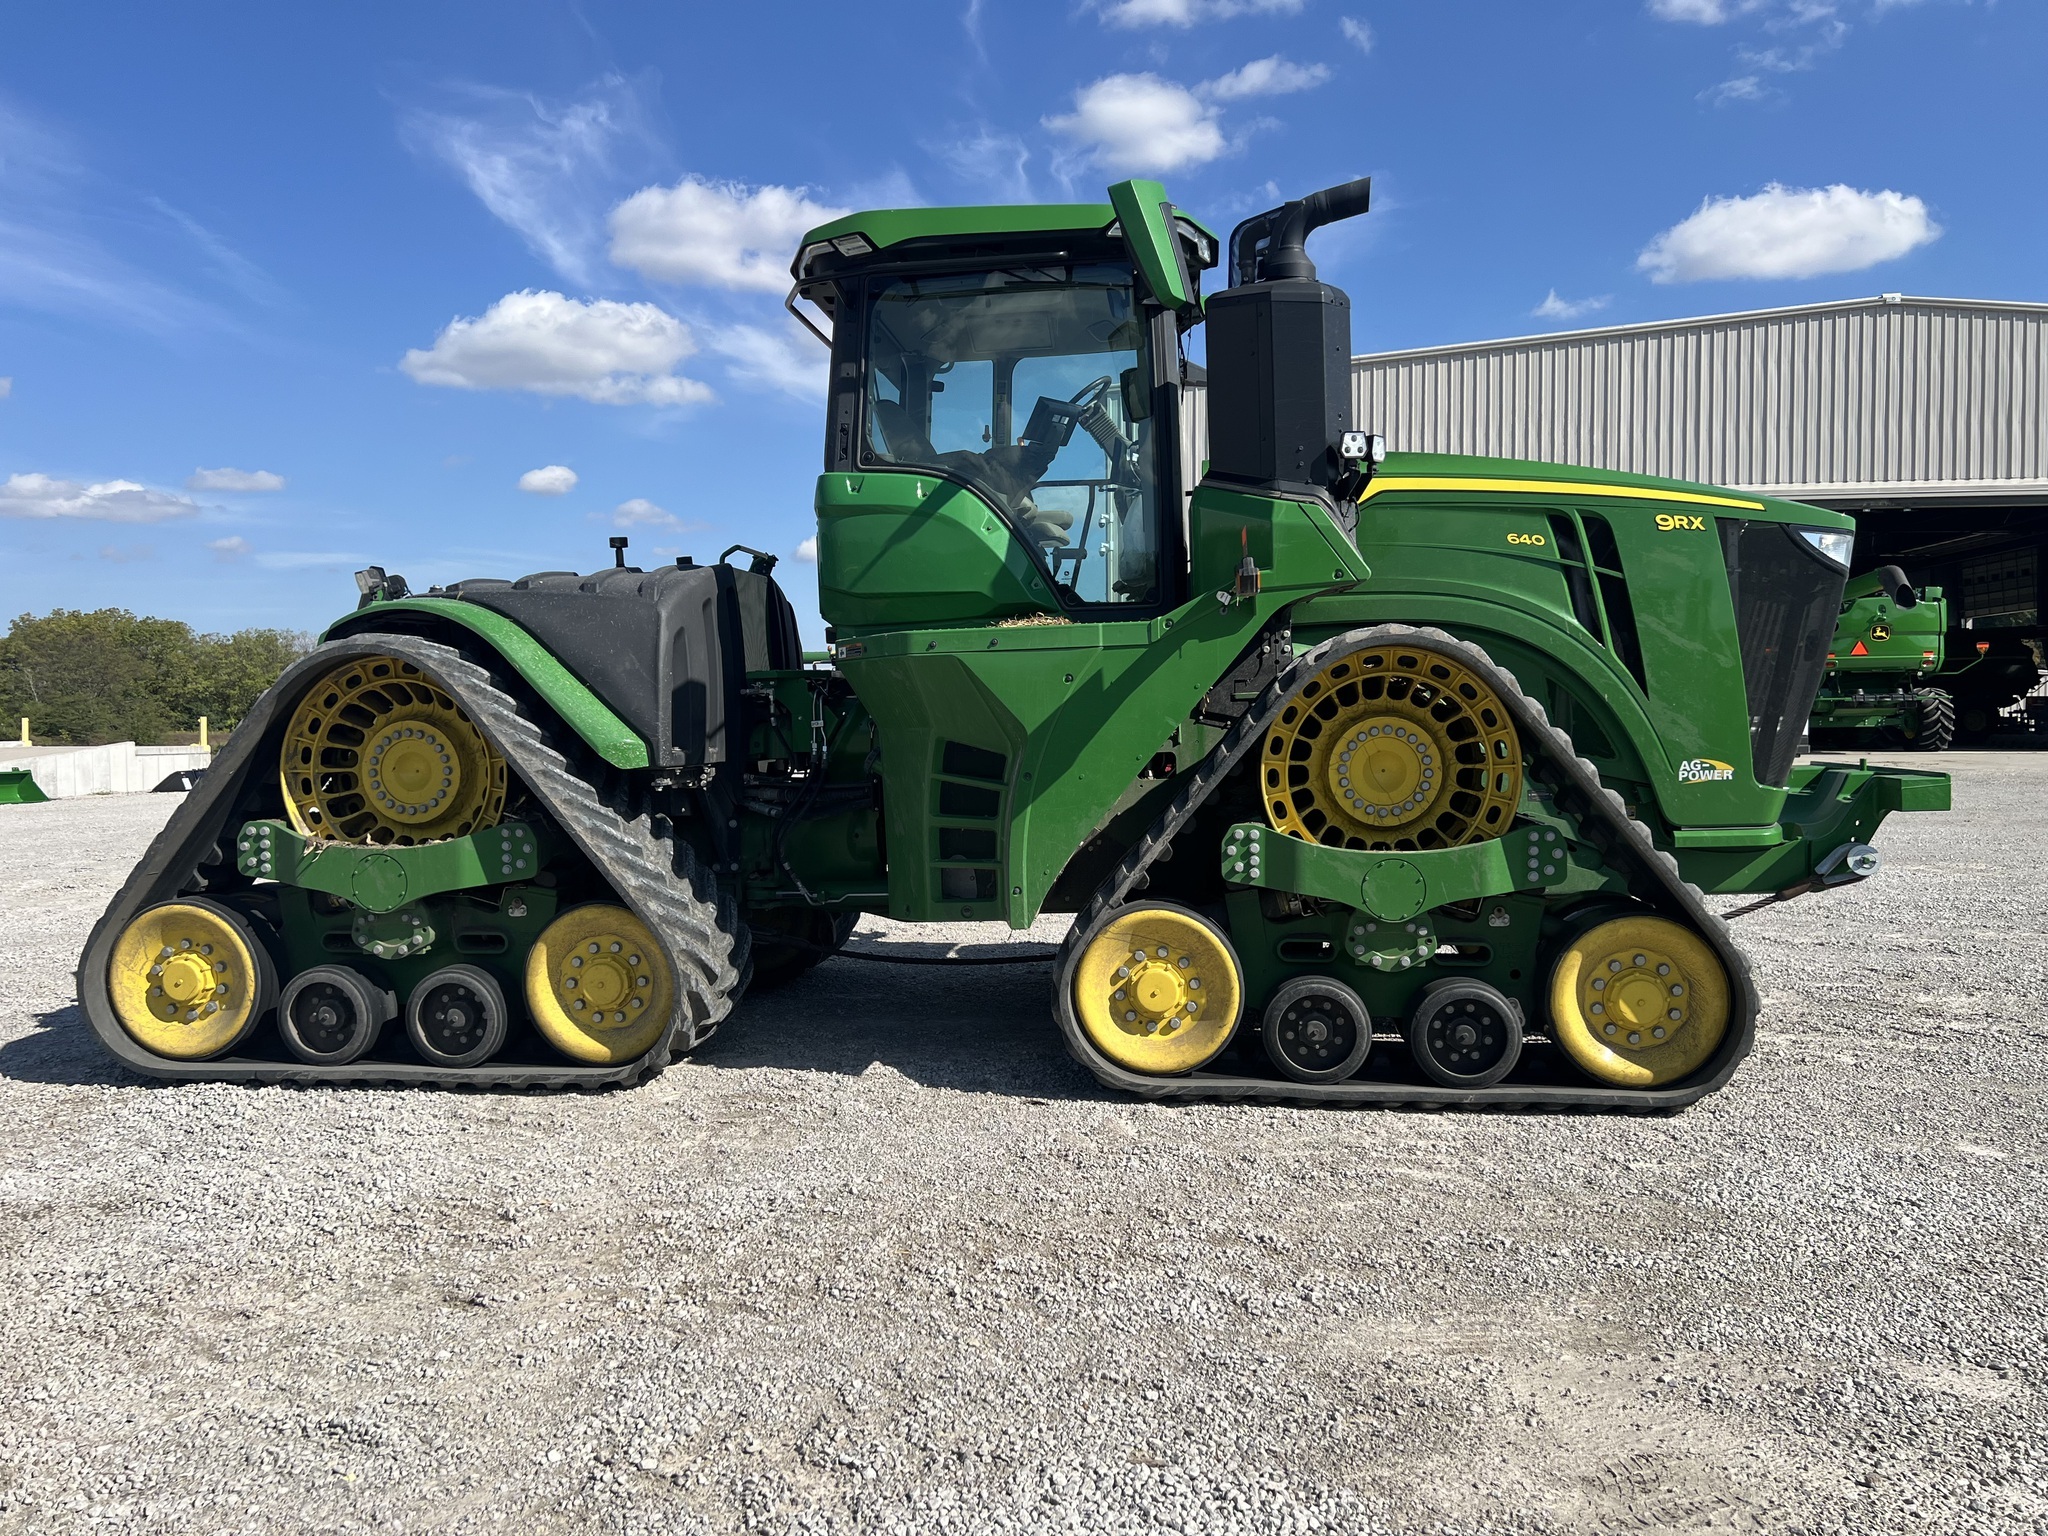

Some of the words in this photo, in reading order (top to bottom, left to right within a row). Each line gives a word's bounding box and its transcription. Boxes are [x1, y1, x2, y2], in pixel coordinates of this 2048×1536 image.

[1655, 514, 1706, 531] 9RX
[1506, 533, 1546, 547] 640
[1680, 760, 1710, 771] AG-
[1678, 769, 1733, 781] POWER
